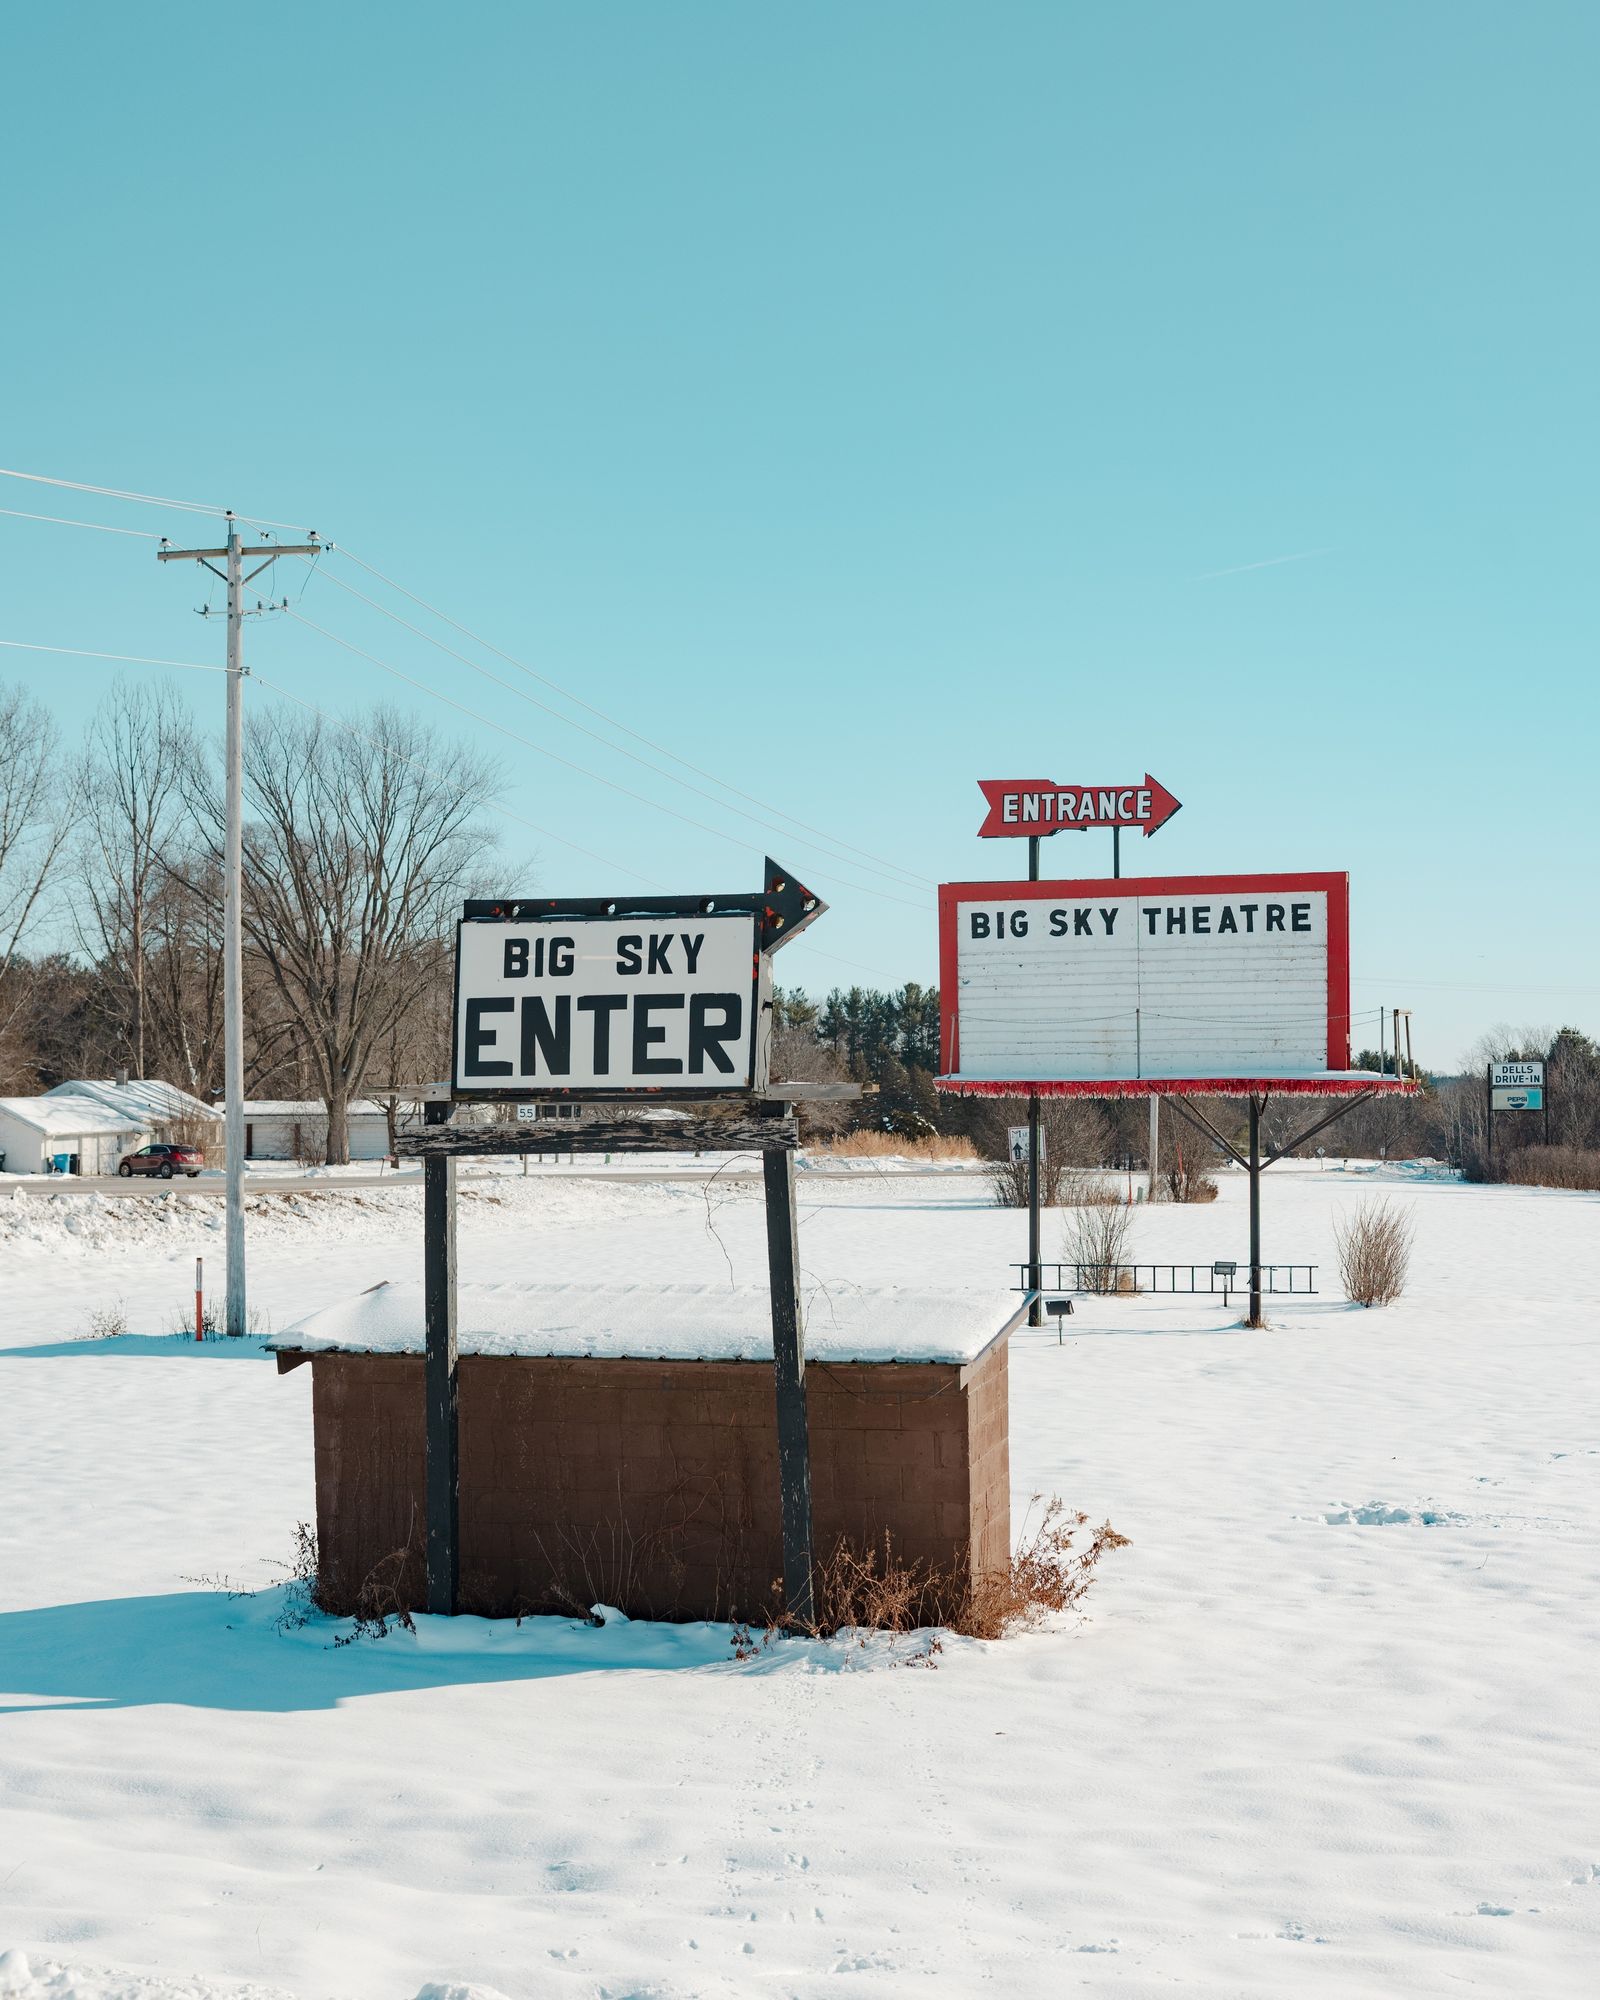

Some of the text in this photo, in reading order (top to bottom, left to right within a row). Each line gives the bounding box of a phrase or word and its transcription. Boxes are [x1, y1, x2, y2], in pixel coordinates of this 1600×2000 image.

[1002, 789, 1152, 824] ENTRANCE
[970, 903, 1312, 940] BIG SKY THEATRE
[503, 933, 705, 978] BIG SKY
[464, 992, 742, 1077] ENTER
[1495, 1074, 1540, 1083] DRIVE-IN
[1502, 1065, 1534, 1074] DELLS
[519, 1108, 534, 1118] 55
